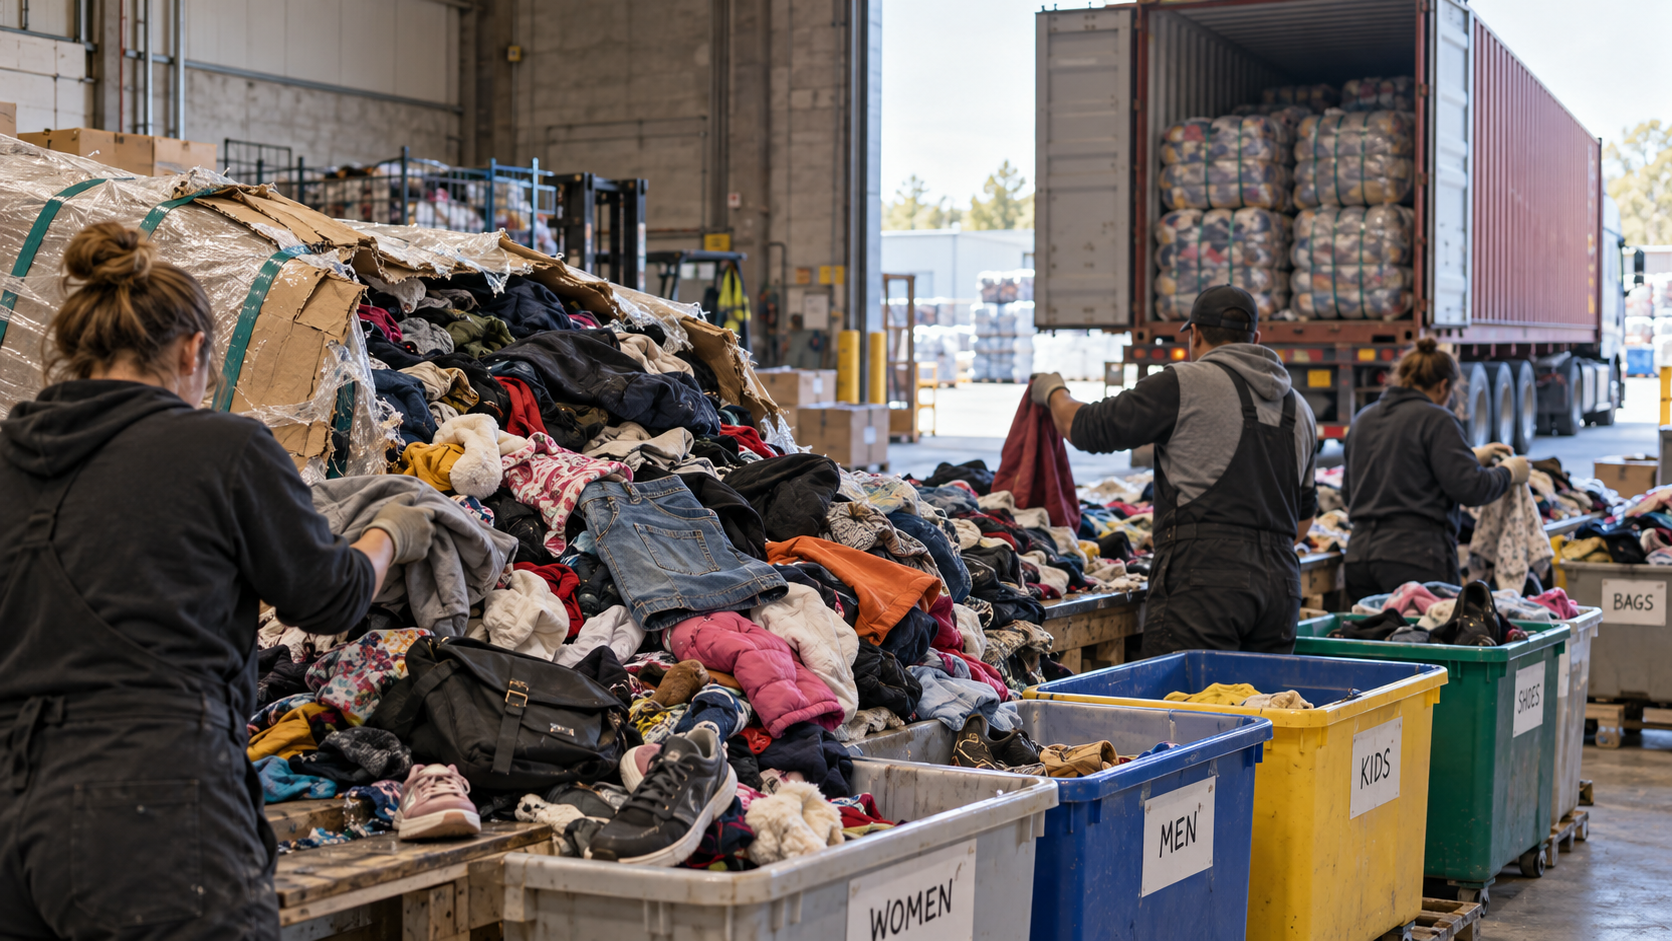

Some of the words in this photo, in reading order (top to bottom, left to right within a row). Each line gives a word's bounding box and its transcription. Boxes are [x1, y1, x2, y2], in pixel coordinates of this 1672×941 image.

[1613, 592, 1654, 611] BAGS
[1517, 683, 1540, 715] SHOES
[1360, 747, 1391, 790] KIDS
[1159, 810, 1197, 858] MEN
[870, 877, 953, 941] WOMEN
